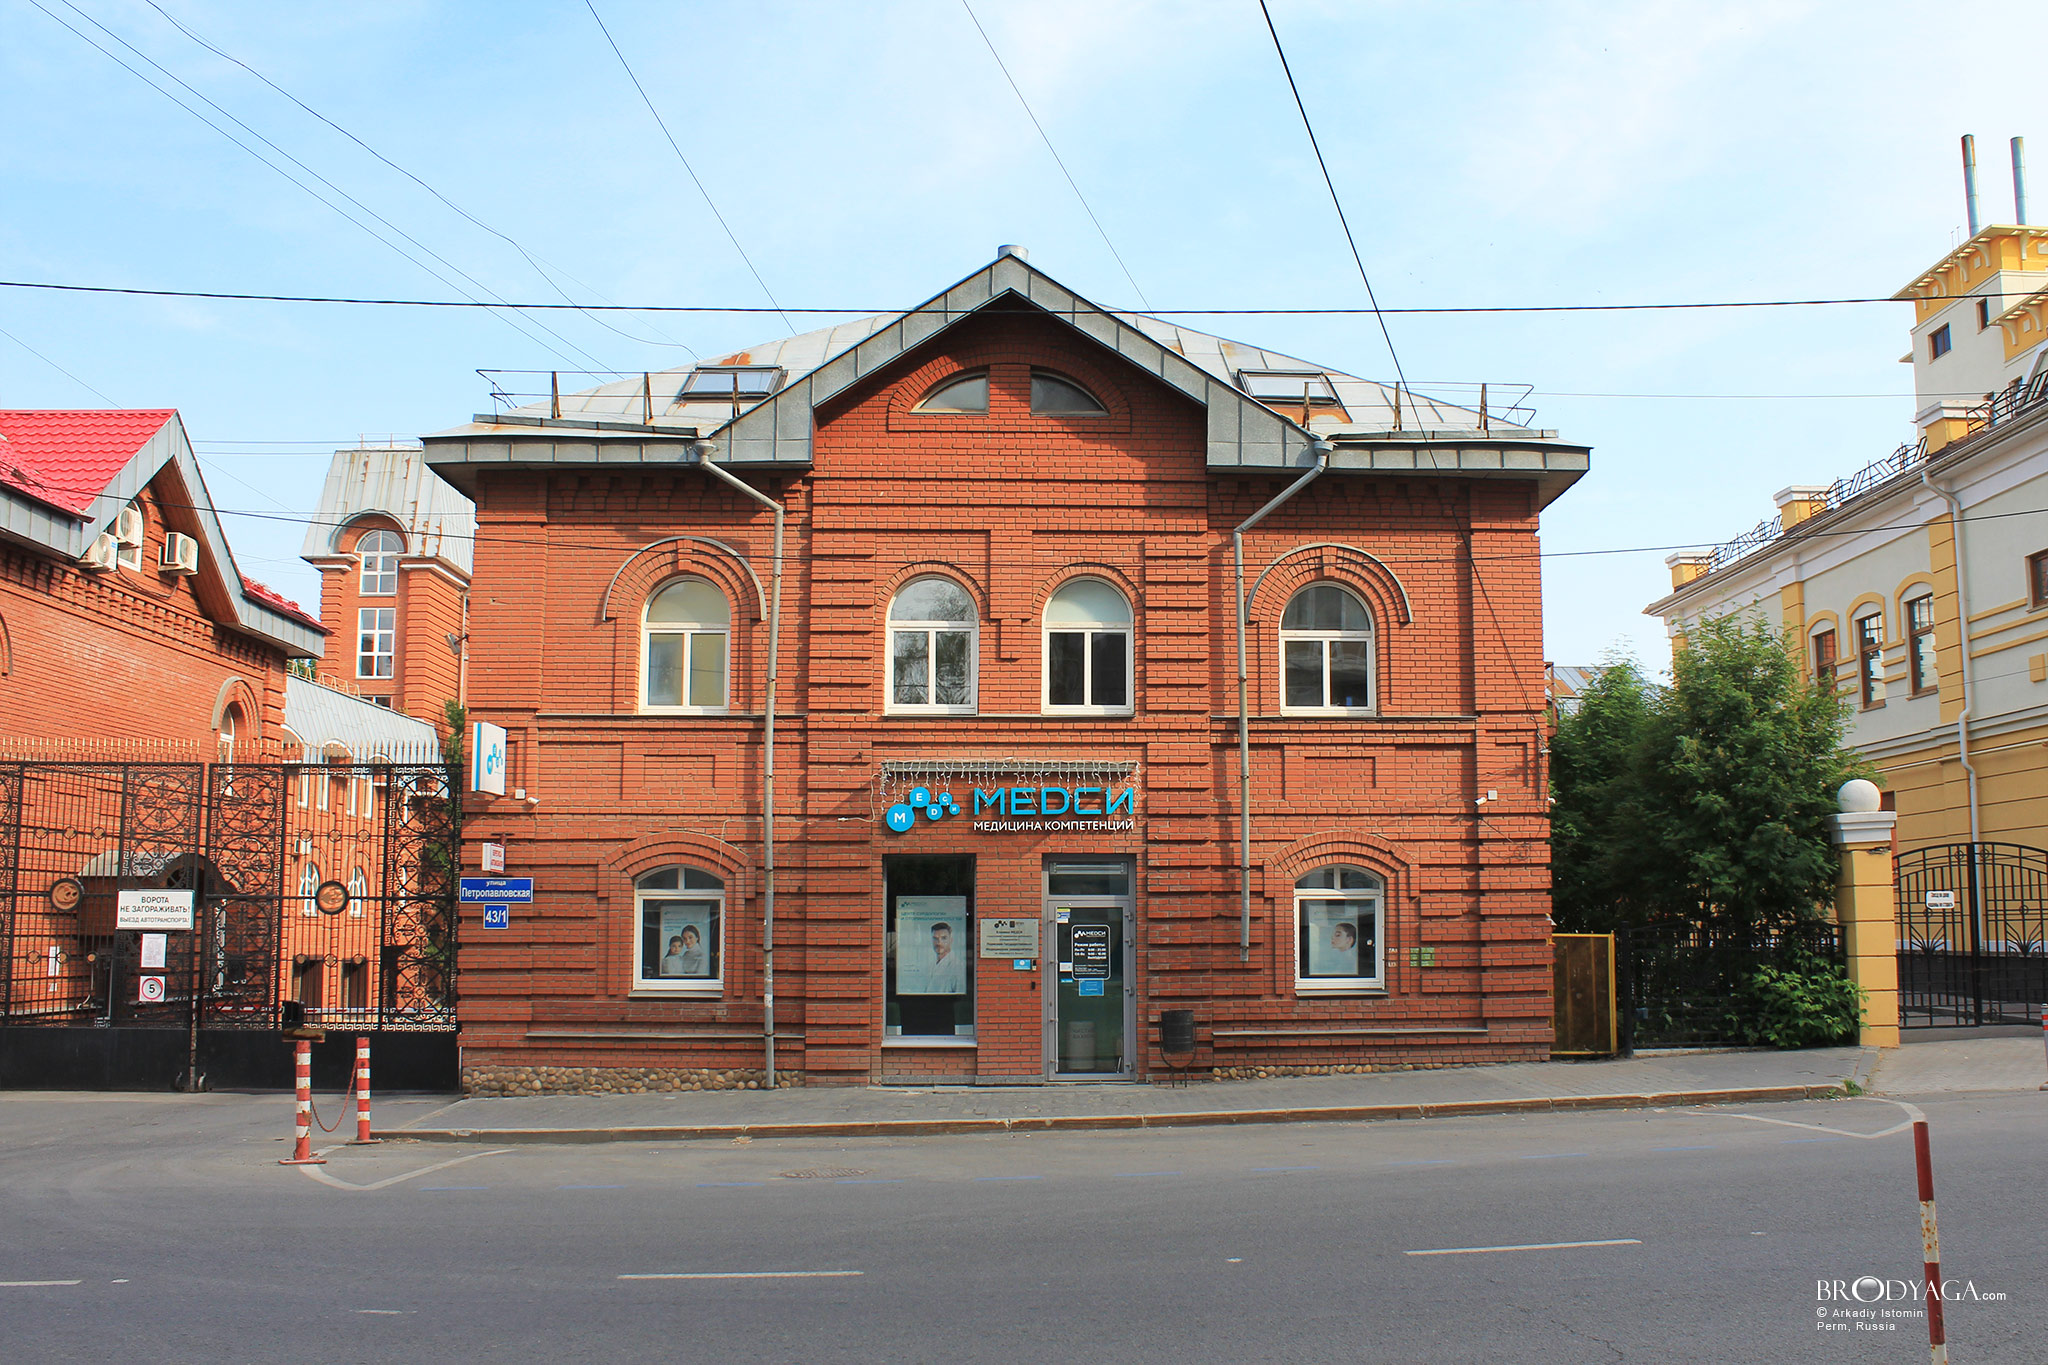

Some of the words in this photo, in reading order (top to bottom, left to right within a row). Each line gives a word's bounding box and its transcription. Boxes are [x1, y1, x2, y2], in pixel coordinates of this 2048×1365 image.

[973, 821, 1043, 832] МЕДИЦИНА
[1045, 819, 1134, 831] КОМПЕТЕНЦИЙ
[461, 888, 531, 899] Петропавловская
[141, 896, 170, 904] ВОРОТА
[485, 910, 507, 923] 43/1
[149, 984, 155, 993] 5
